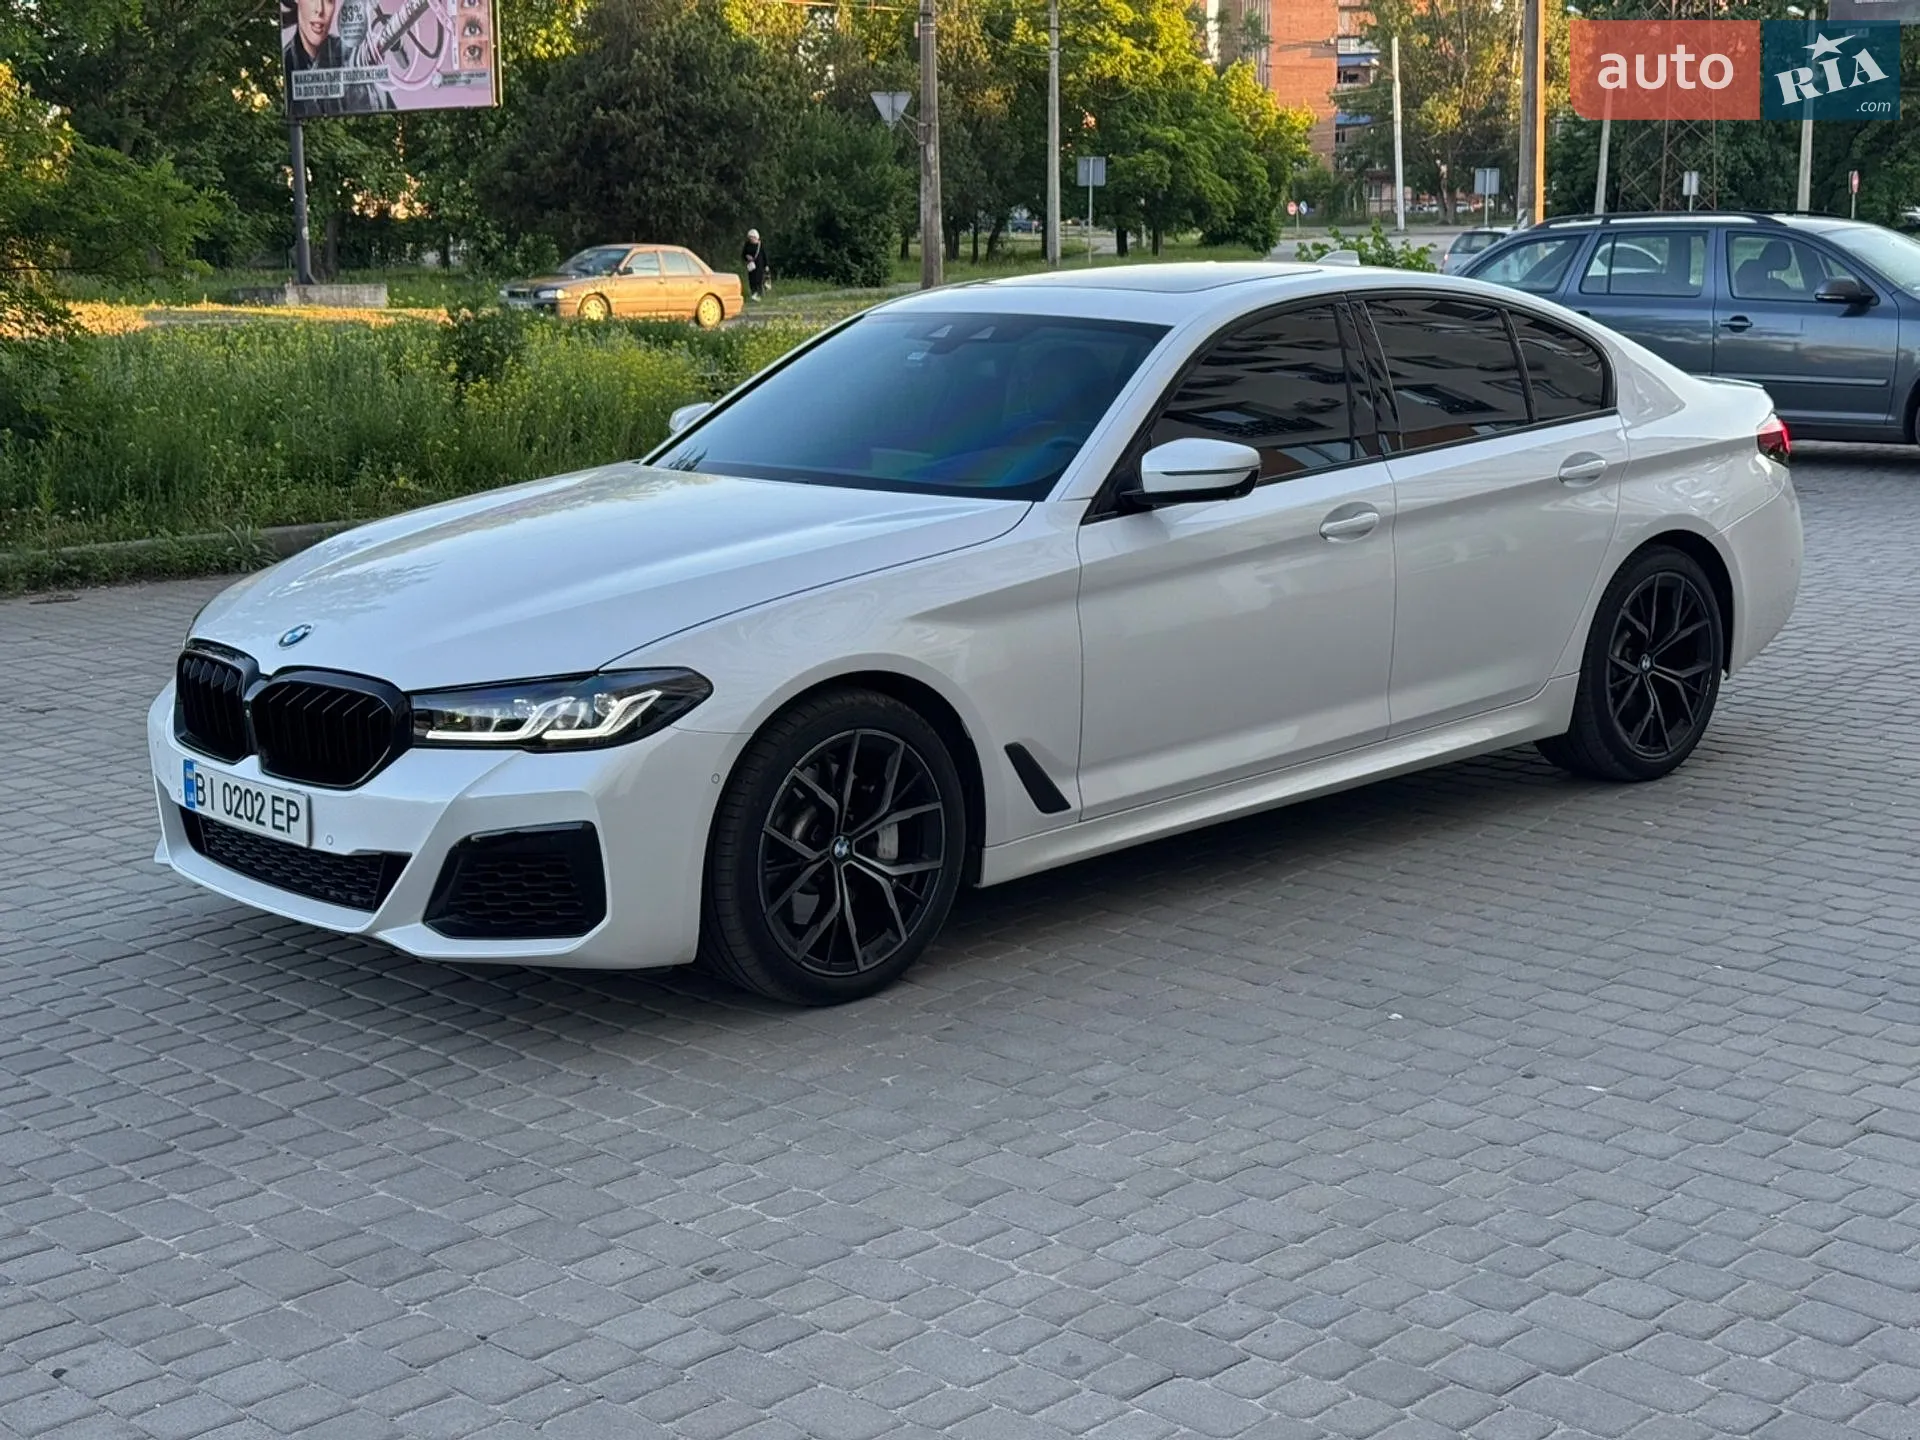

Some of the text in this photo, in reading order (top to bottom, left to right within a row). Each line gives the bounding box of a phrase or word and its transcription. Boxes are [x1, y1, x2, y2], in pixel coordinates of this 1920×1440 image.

[195, 772, 300, 834] BI 0202 EP
